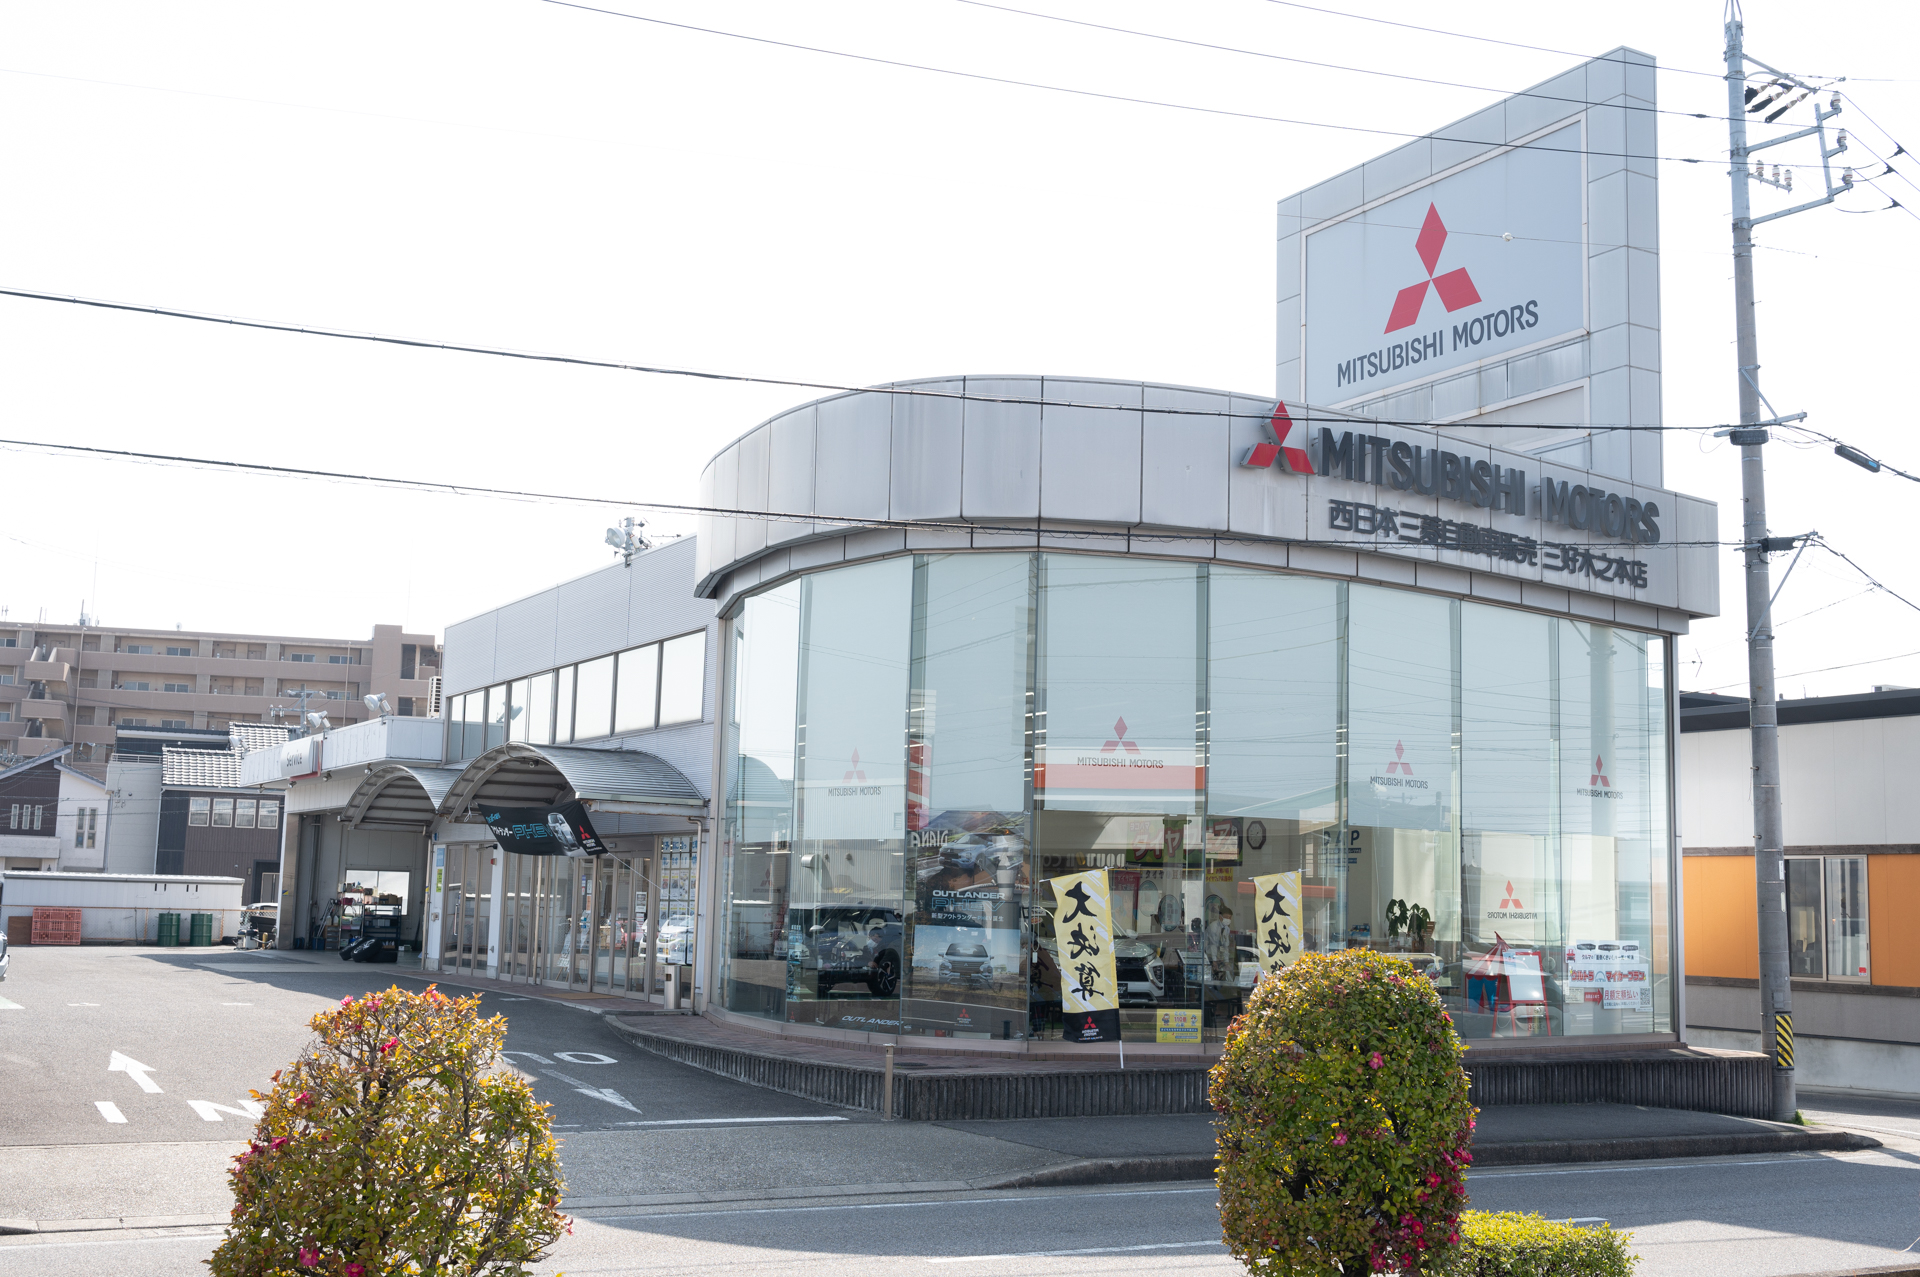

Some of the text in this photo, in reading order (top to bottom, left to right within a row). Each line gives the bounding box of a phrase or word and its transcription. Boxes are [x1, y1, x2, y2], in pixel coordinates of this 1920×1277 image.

[1337, 299, 1540, 388] MITSUBISHI MOTORS
[1317, 426, 1661, 544] MITSUBISHI MOTORS
[1328, 498, 1538, 567] 西日本三菱自動車販売
[286, 750, 303, 768] Service
[1077, 756, 1164, 769] MITSUBISHI MOTORS
[1370, 776, 1429, 789] MITSUBISHI MOTORS
[828, 786, 882, 797] MITSUBISHI MOTORS
[1576, 788, 1624, 799] MITSUBISHI MOTORS
[932, 889, 1006, 899] OUTLANDER
[931, 897, 1006, 912] PHEV
[1571, 969, 1595, 983] ウルトラ
[841, 1015, 904, 1026] OUTLANDER
